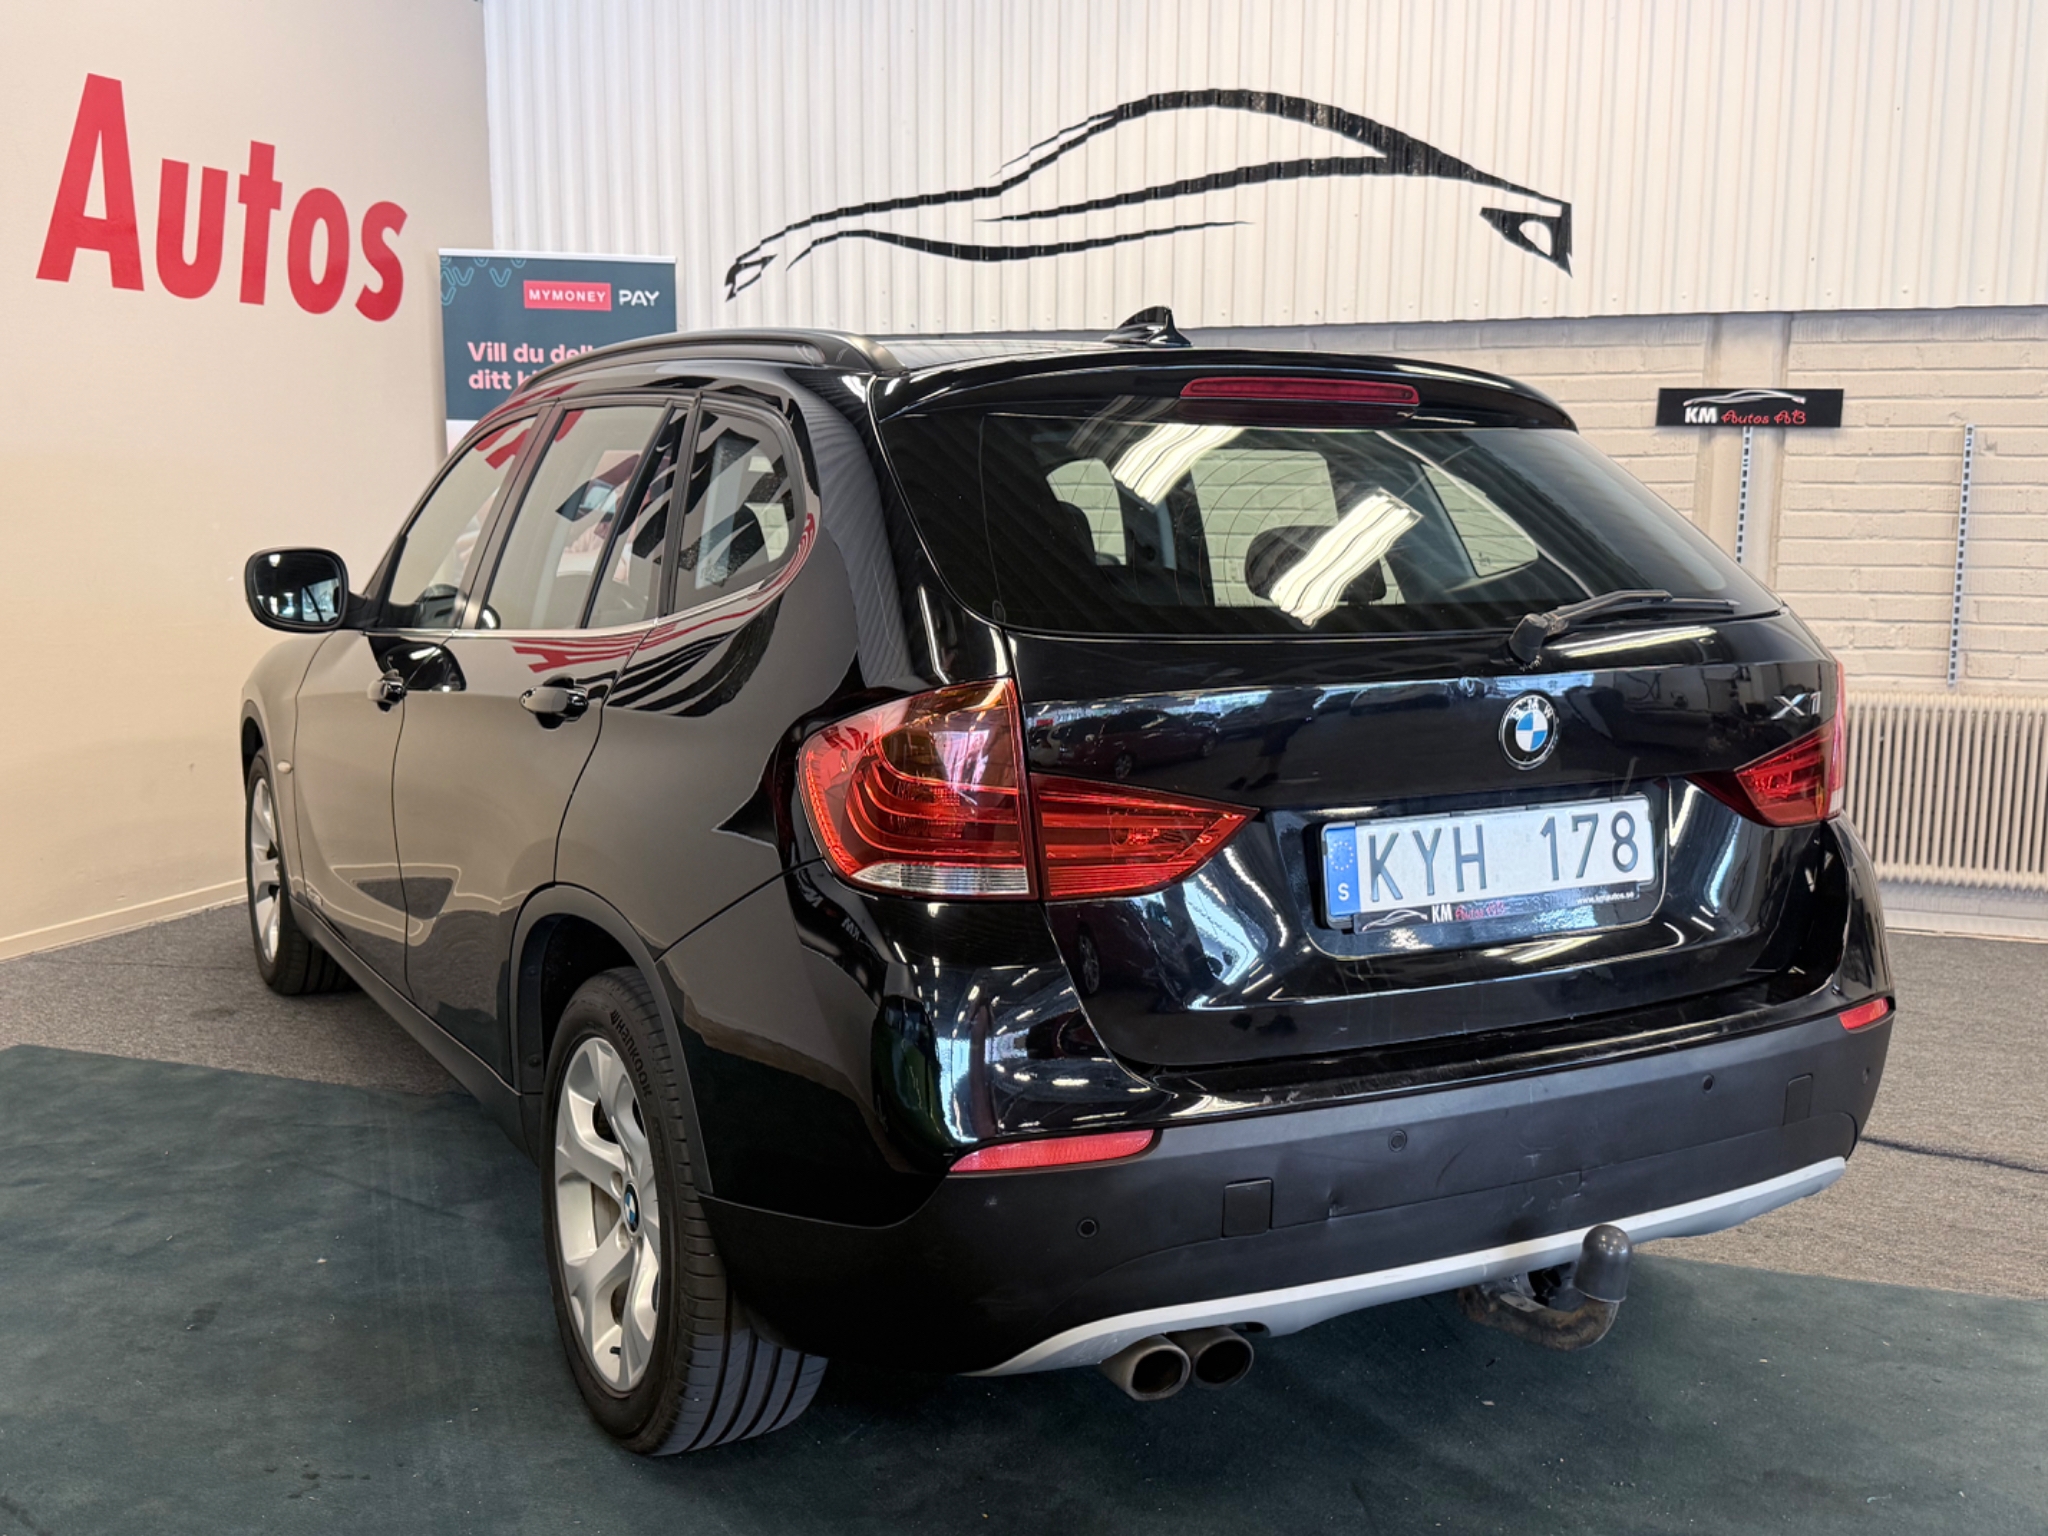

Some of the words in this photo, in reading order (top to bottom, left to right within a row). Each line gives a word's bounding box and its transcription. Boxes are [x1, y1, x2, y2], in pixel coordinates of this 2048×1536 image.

[36, 72, 408, 322] Autos
[528, 288, 606, 302] MYMONEY
[618, 289, 660, 307] PAY
[467, 341, 507, 362] Vill
[513, 343, 544, 363] du
[468, 369, 512, 389] ditt
[1684, 406, 1718, 424] KM
[1721, 409, 1770, 424] Autos
[1774, 409, 1807, 424] AB
[1771, 691, 1821, 720] X1
[1368, 824, 1488, 902] KYH
[1540, 810, 1639, 881] 178
[1337, 882, 1350, 901] S
[1431, 903, 1453, 924] KM
